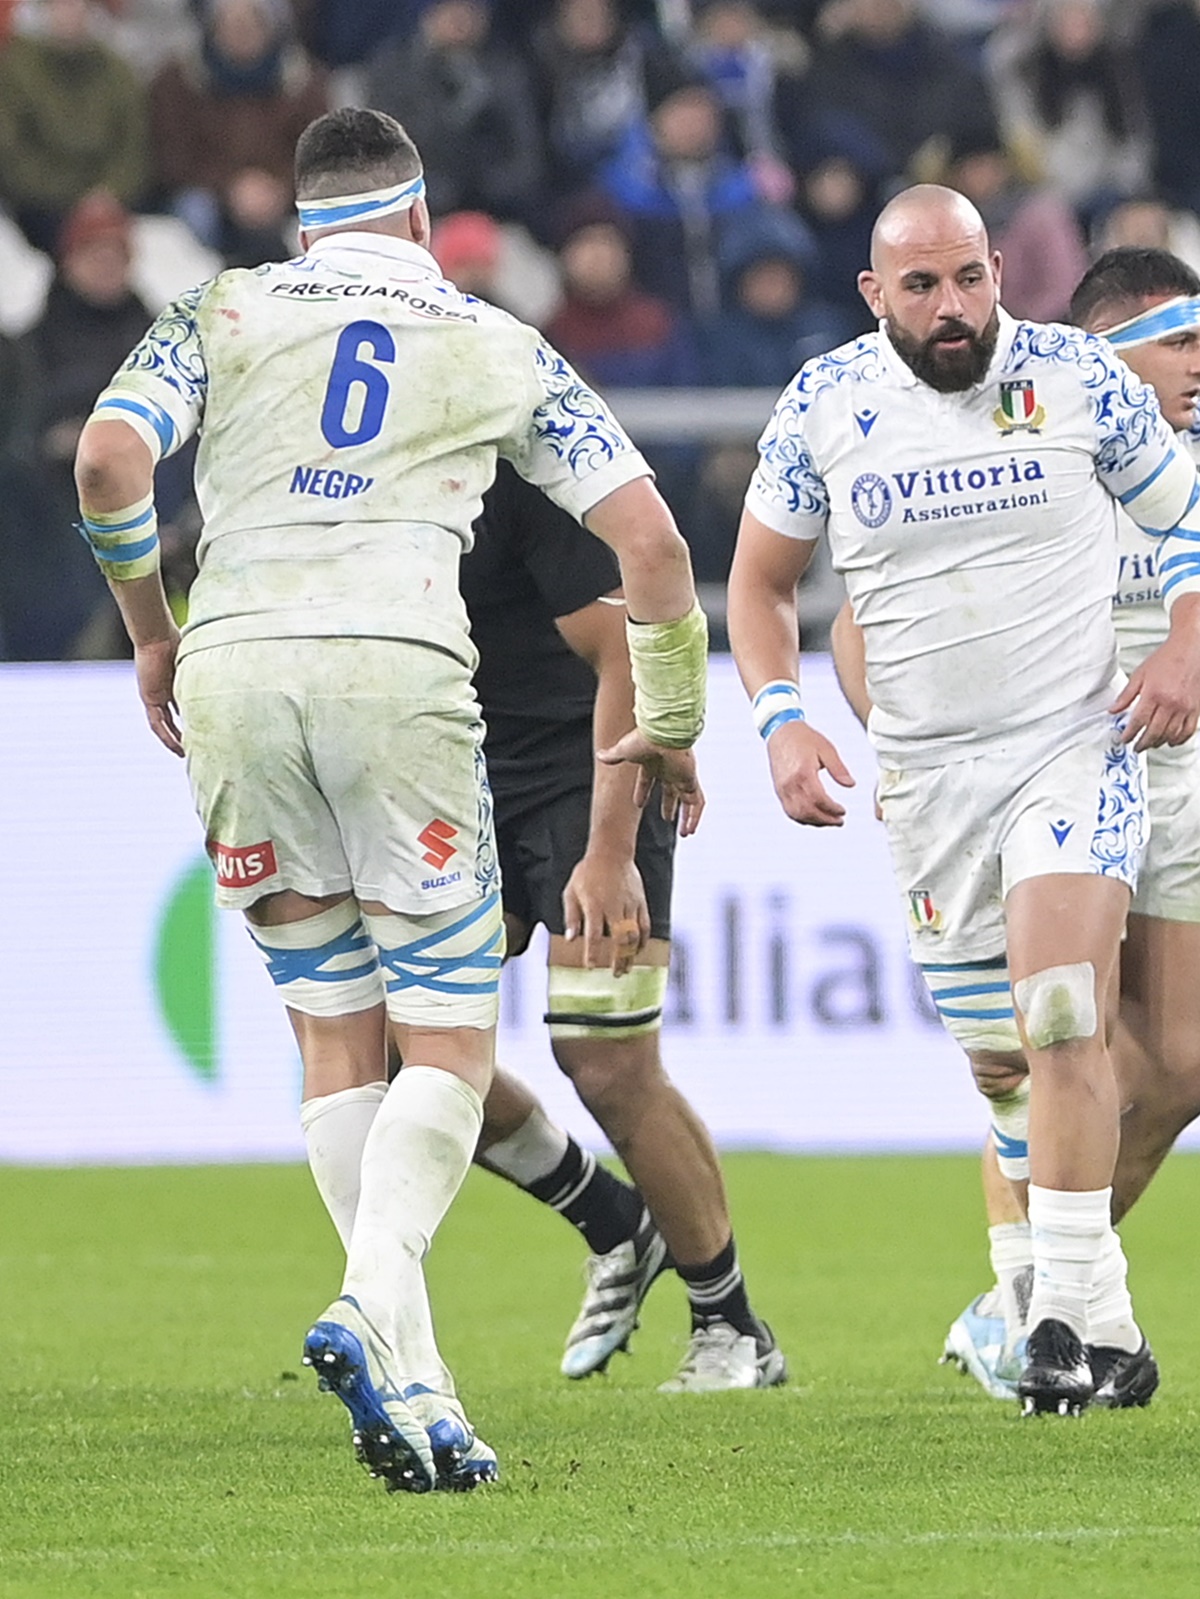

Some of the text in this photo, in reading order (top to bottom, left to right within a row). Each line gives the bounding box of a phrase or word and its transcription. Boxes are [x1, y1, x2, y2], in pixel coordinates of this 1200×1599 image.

[271, 282, 479, 323] FRECCIAROSSA
[320, 319, 396, 449] 6
[892, 457, 1045, 499] Vittoria
[901, 489, 1049, 524] Assicurazioni
